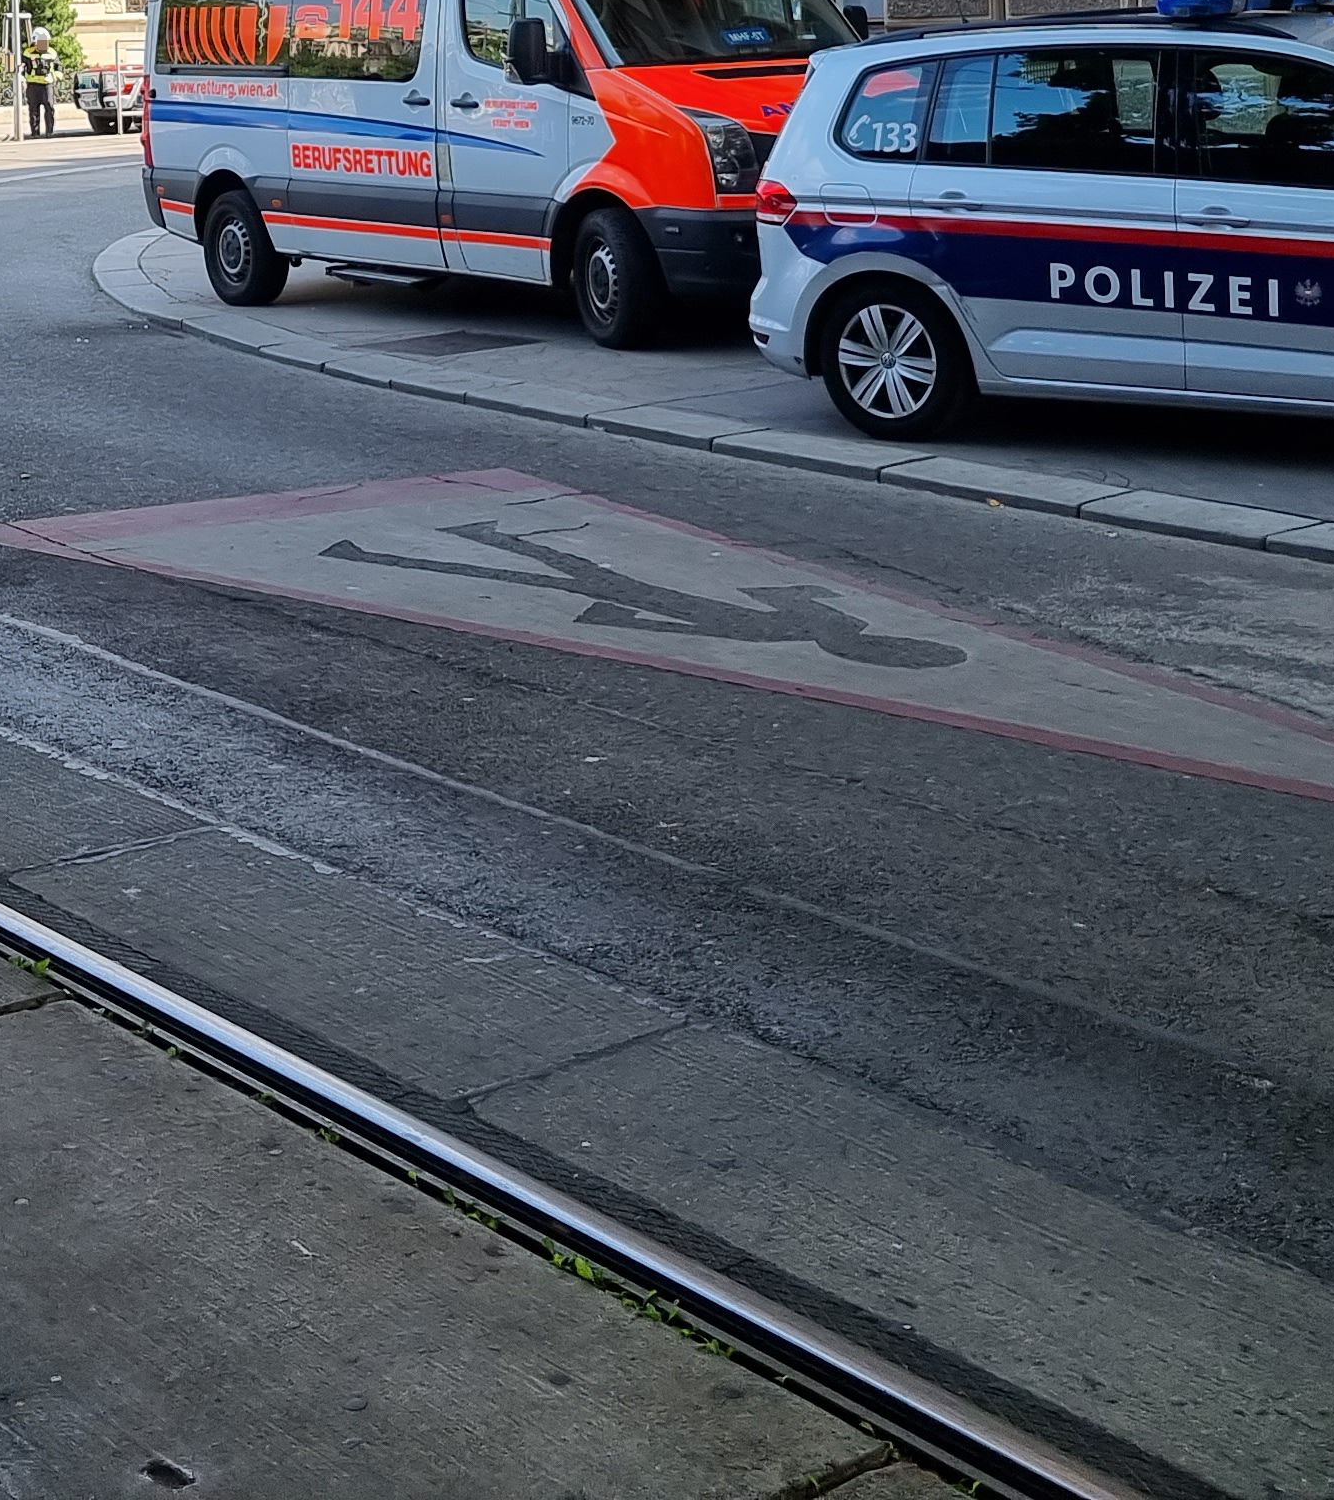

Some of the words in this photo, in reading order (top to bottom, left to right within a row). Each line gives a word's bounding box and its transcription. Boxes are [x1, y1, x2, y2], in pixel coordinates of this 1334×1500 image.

[170, 79, 279, 98] www.rettung.wien.at
[872, 122, 917, 153] 133
[291, 143, 434, 178] BERUFSRETTUNG
[1049, 262, 1279, 317] POLIZEI
